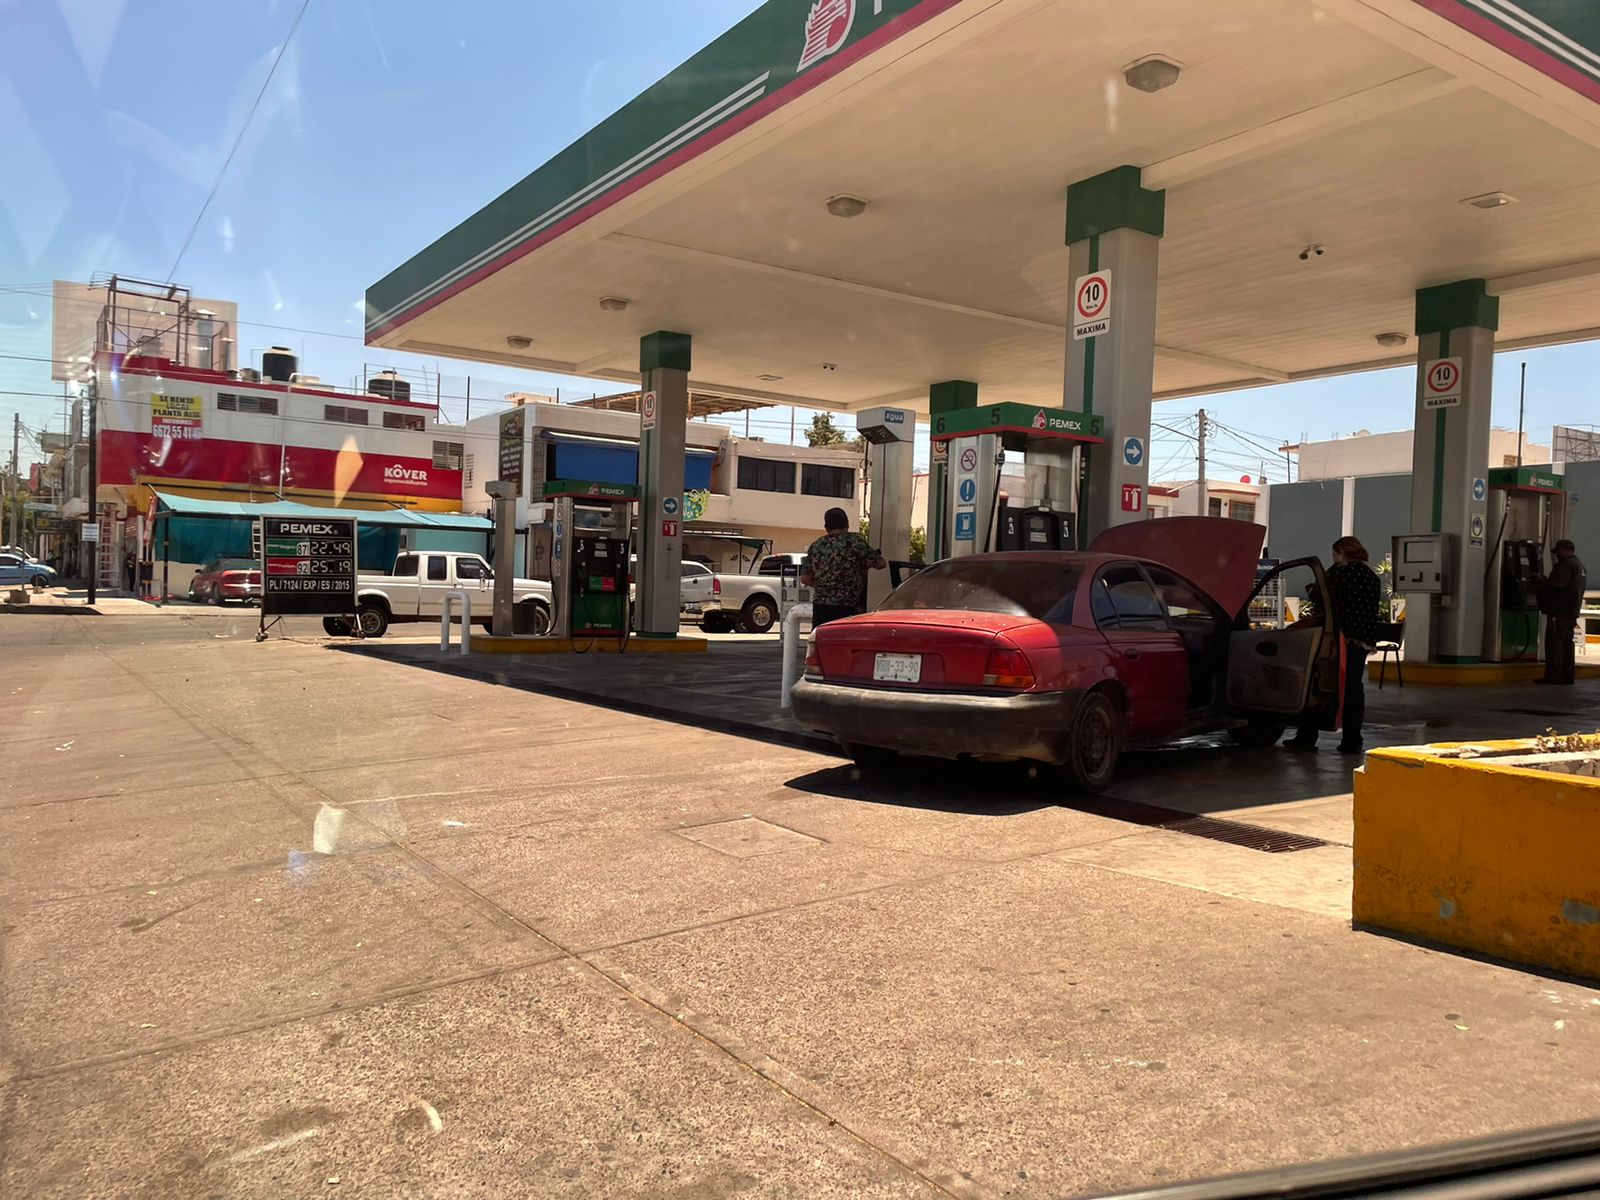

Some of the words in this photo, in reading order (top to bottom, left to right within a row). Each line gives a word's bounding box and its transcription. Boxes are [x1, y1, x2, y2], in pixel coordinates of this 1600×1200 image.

[1085, 284, 1099, 303] 10
[1077, 323, 1106, 336] MAXIMA
[1436, 367, 1450, 381] 10
[1427, 398, 1457, 406] MAXIMA
[153, 409, 181, 417] PLANTA
[885, 412, 903, 422] agua
[936, 417, 945, 433] 6
[991, 408, 1000, 424] 5
[1049, 419, 1081, 430] PEMEX
[1091, 419, 1100, 434] 5
[280, 523, 333, 534] PEMEX
[297, 543, 309, 555] 87
[311, 541, 351, 554] 22.49
[297, 562, 309, 574] 92
[311, 560, 351, 573] 25.19
